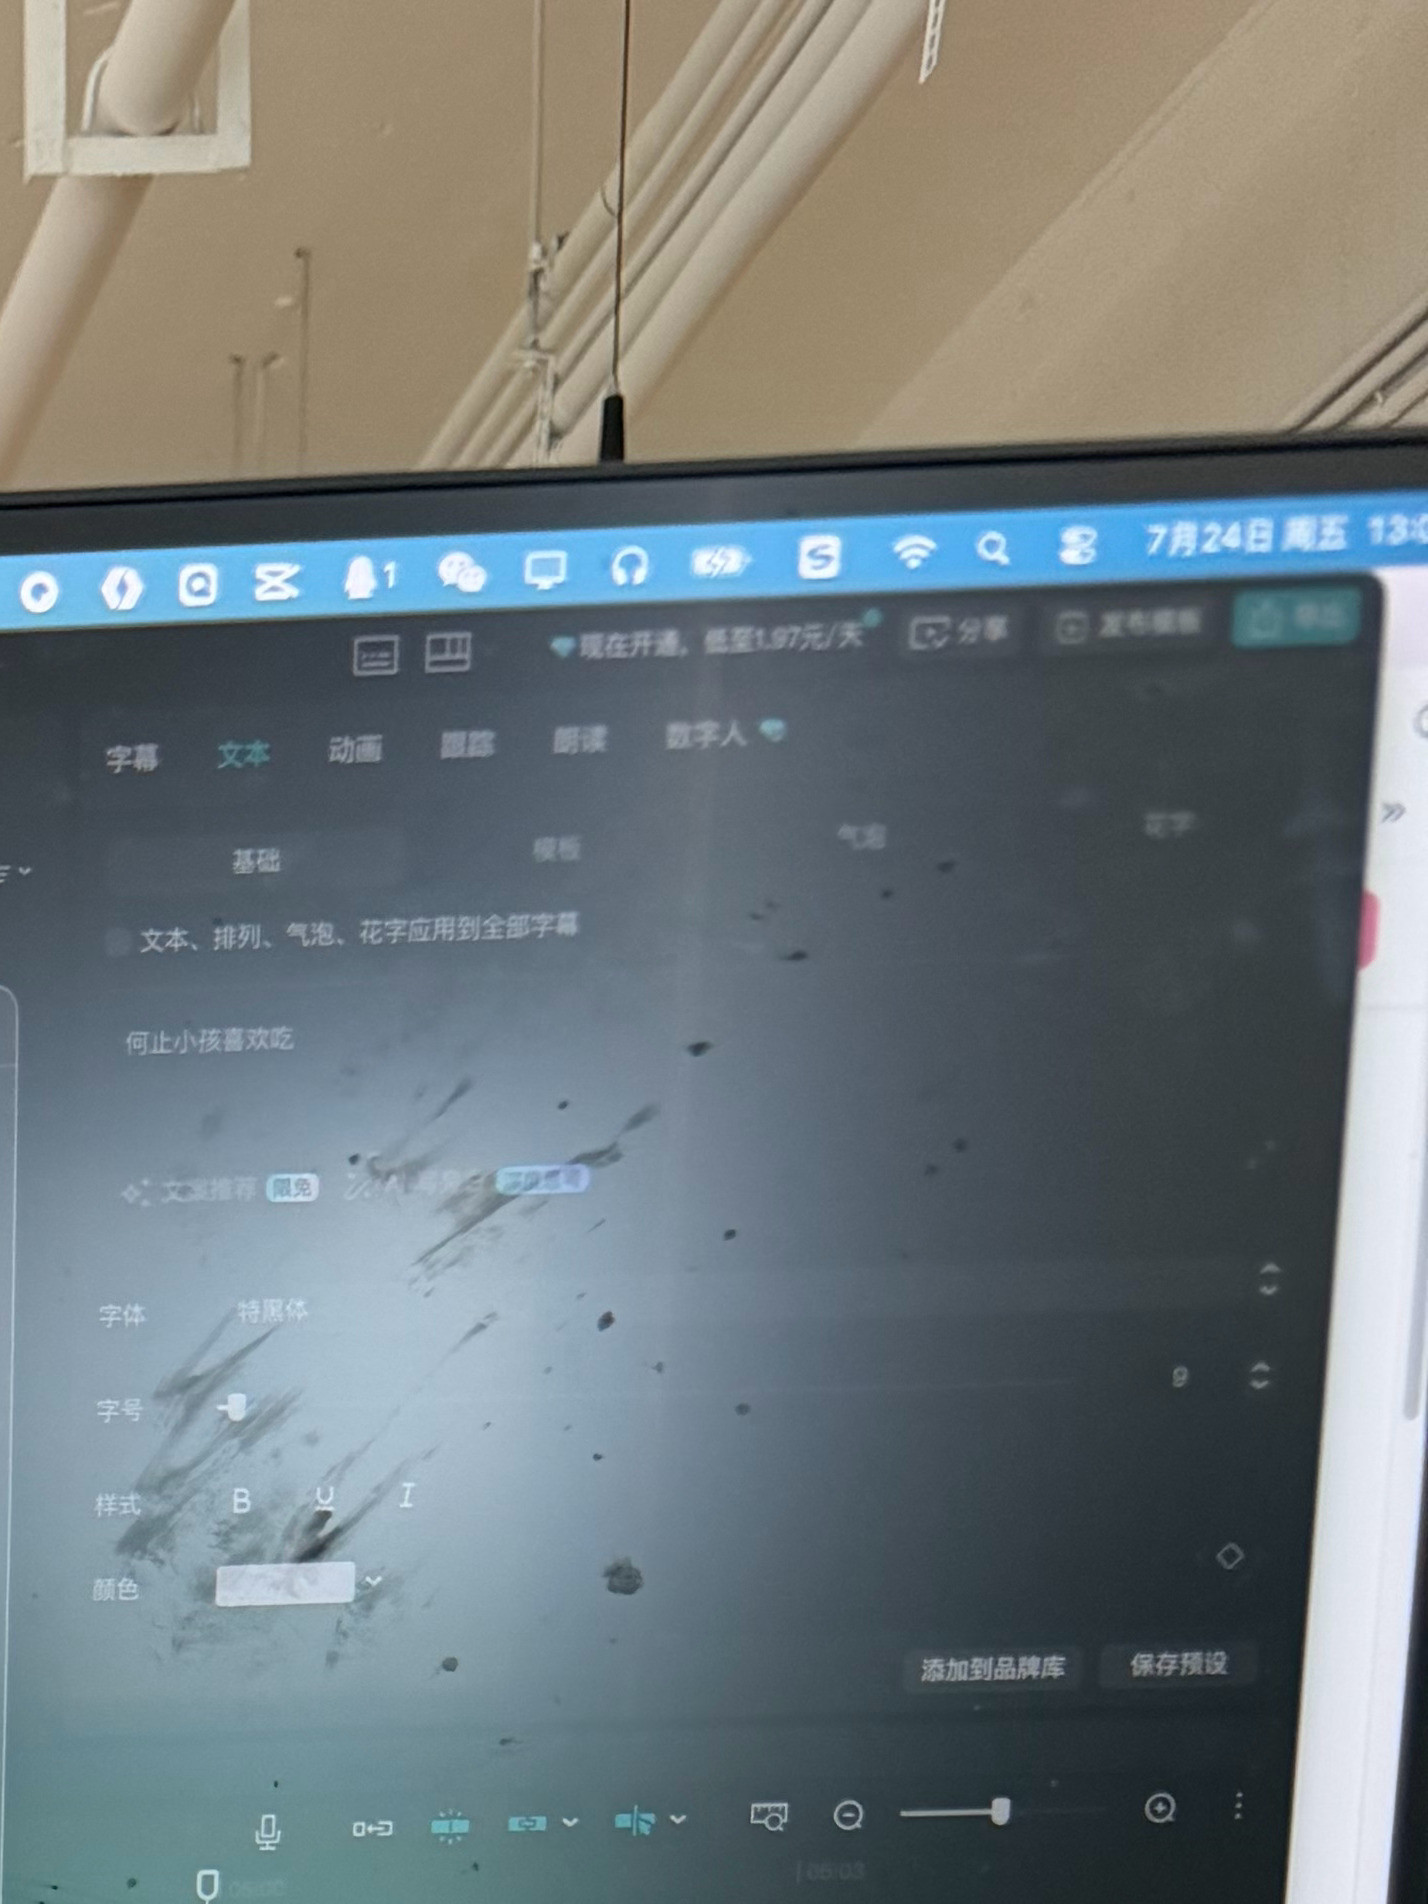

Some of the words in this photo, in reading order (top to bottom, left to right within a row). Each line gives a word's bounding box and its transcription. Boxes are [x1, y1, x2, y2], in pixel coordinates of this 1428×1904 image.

[1147, 519, 1274, 557] 7月24日
[1281, 514, 1350, 552] 周五
[328, 735, 382, 763] 动画
[665, 721, 747, 750] 数字人
[105, 745, 159, 773] 字幕
[218, 740, 271, 768] 文本
[232, 848, 280, 874] 基础
[126, 1027, 294, 1055] 何止小孩喜欢吃
[99, 1304, 145, 1328] 字体
[97, 1399, 143, 1422] 字号
[96, 1493, 141, 1517] 样式
[93, 1577, 140, 1602] 颜色
[921, 1656, 1066, 1682] 添加到品牌库
[1130, 1650, 1229, 1677] 保存预设
